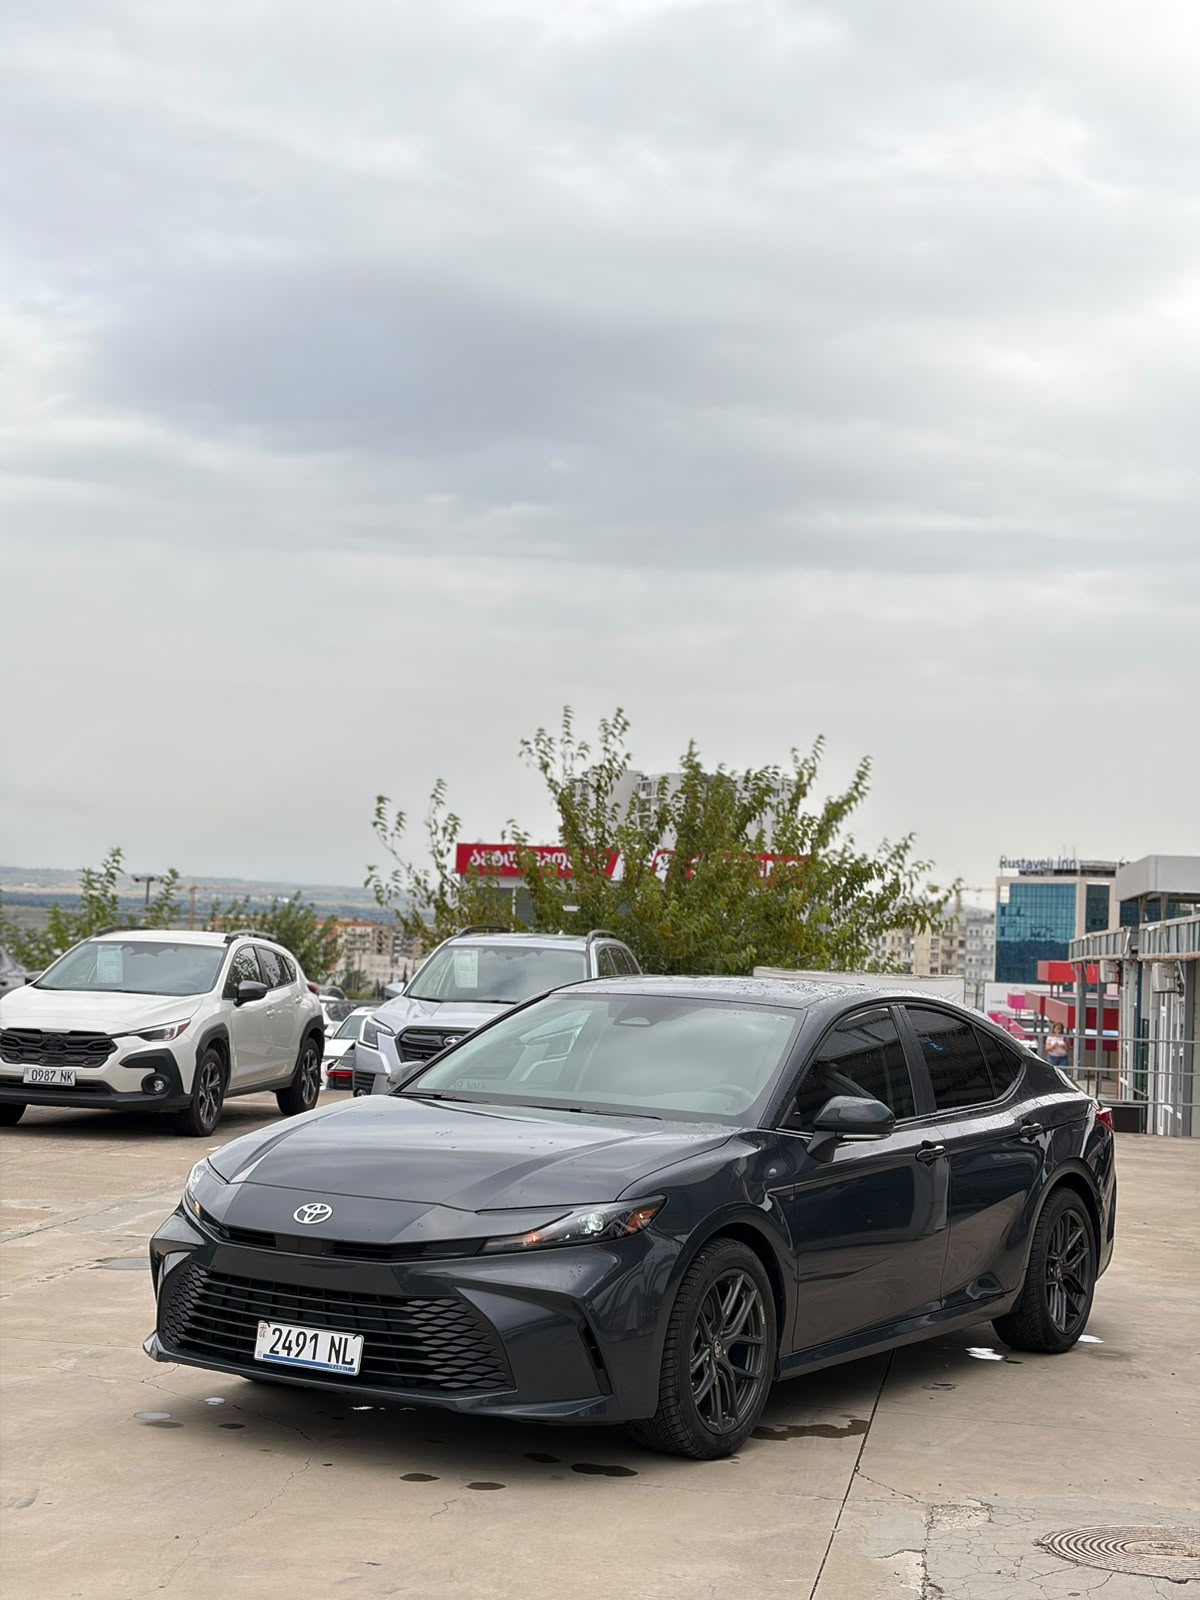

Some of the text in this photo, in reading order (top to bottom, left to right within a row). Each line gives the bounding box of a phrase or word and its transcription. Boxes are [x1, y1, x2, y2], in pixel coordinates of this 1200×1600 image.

[999, 855, 1054, 870] Rustaveli
[31, 1069, 73, 1083] 0987 NK
[269, 1327, 355, 1365] 2491 NL
